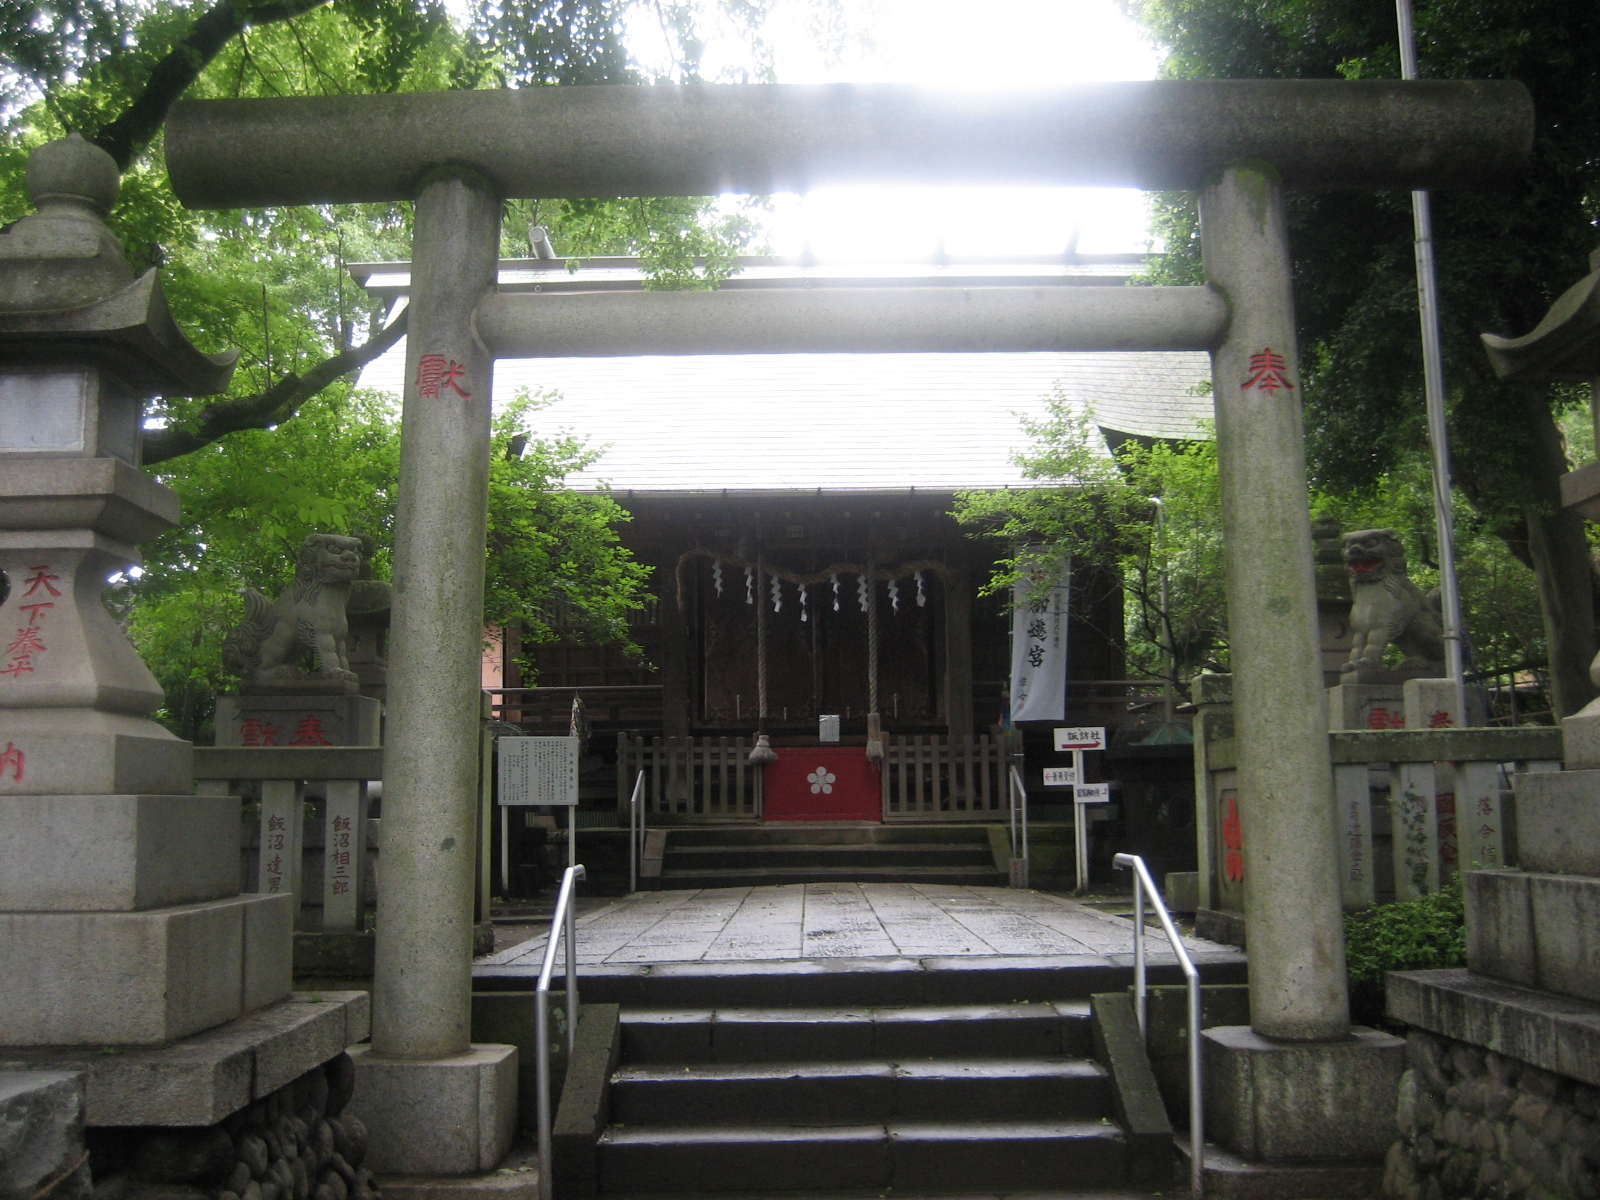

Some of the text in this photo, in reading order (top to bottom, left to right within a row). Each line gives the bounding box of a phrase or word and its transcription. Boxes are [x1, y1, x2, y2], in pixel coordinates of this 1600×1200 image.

[1240, 347, 1294, 397] 奉
[0, 565, 62, 678] 天下泰平
[1067, 731, 1101, 741] 諏訪社
[266, 813, 286, 894] 飯沼達男
[330, 814, 352, 897] 飯沼相三郎
